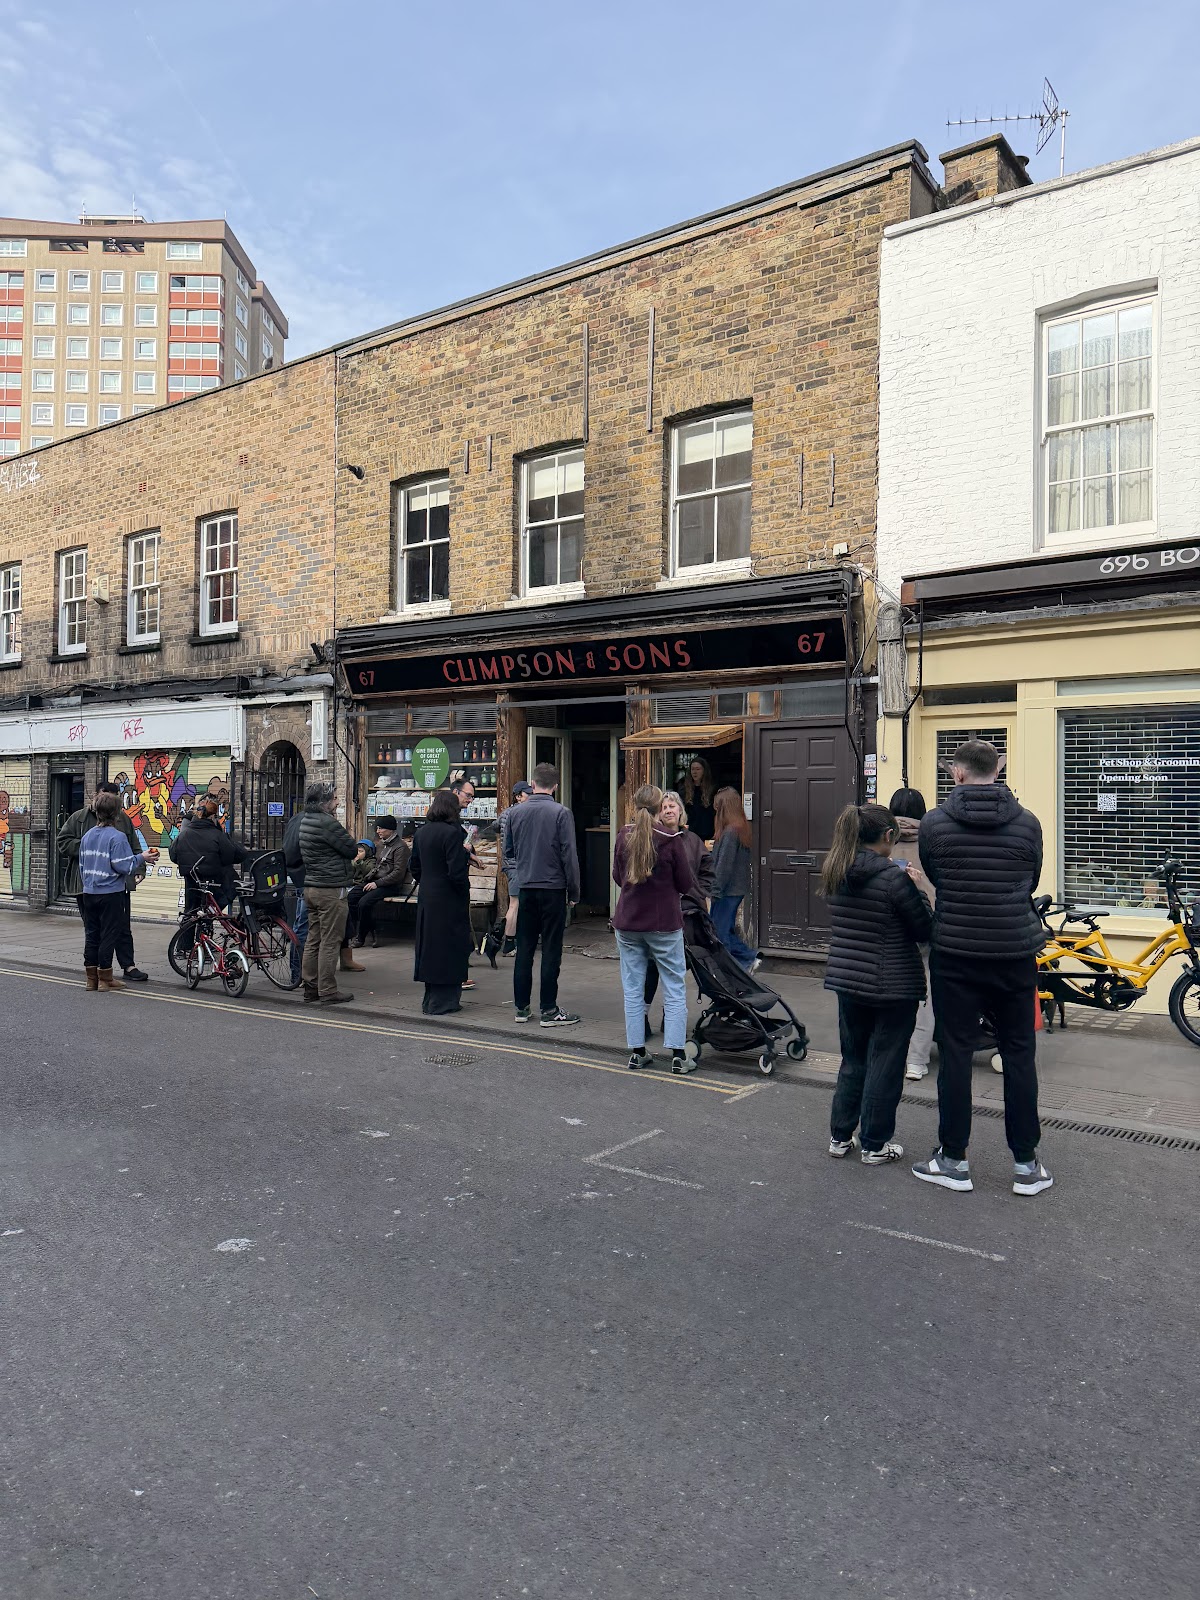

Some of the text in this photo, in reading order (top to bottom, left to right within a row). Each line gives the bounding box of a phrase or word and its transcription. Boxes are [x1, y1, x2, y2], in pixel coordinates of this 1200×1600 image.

[1160, 547, 1200, 567] BO
[359, 670, 375, 687] 67
[442, 649, 576, 683] CLIMPSON
[605, 640, 691, 672] SONS
[796, 632, 826, 654] 67
[1100, 759, 1116, 767] Pet
[1117, 759, 1142, 768] Shop
[1143, 759, 1153, 767] &
[1099, 773, 1168, 784] Opening Soon
